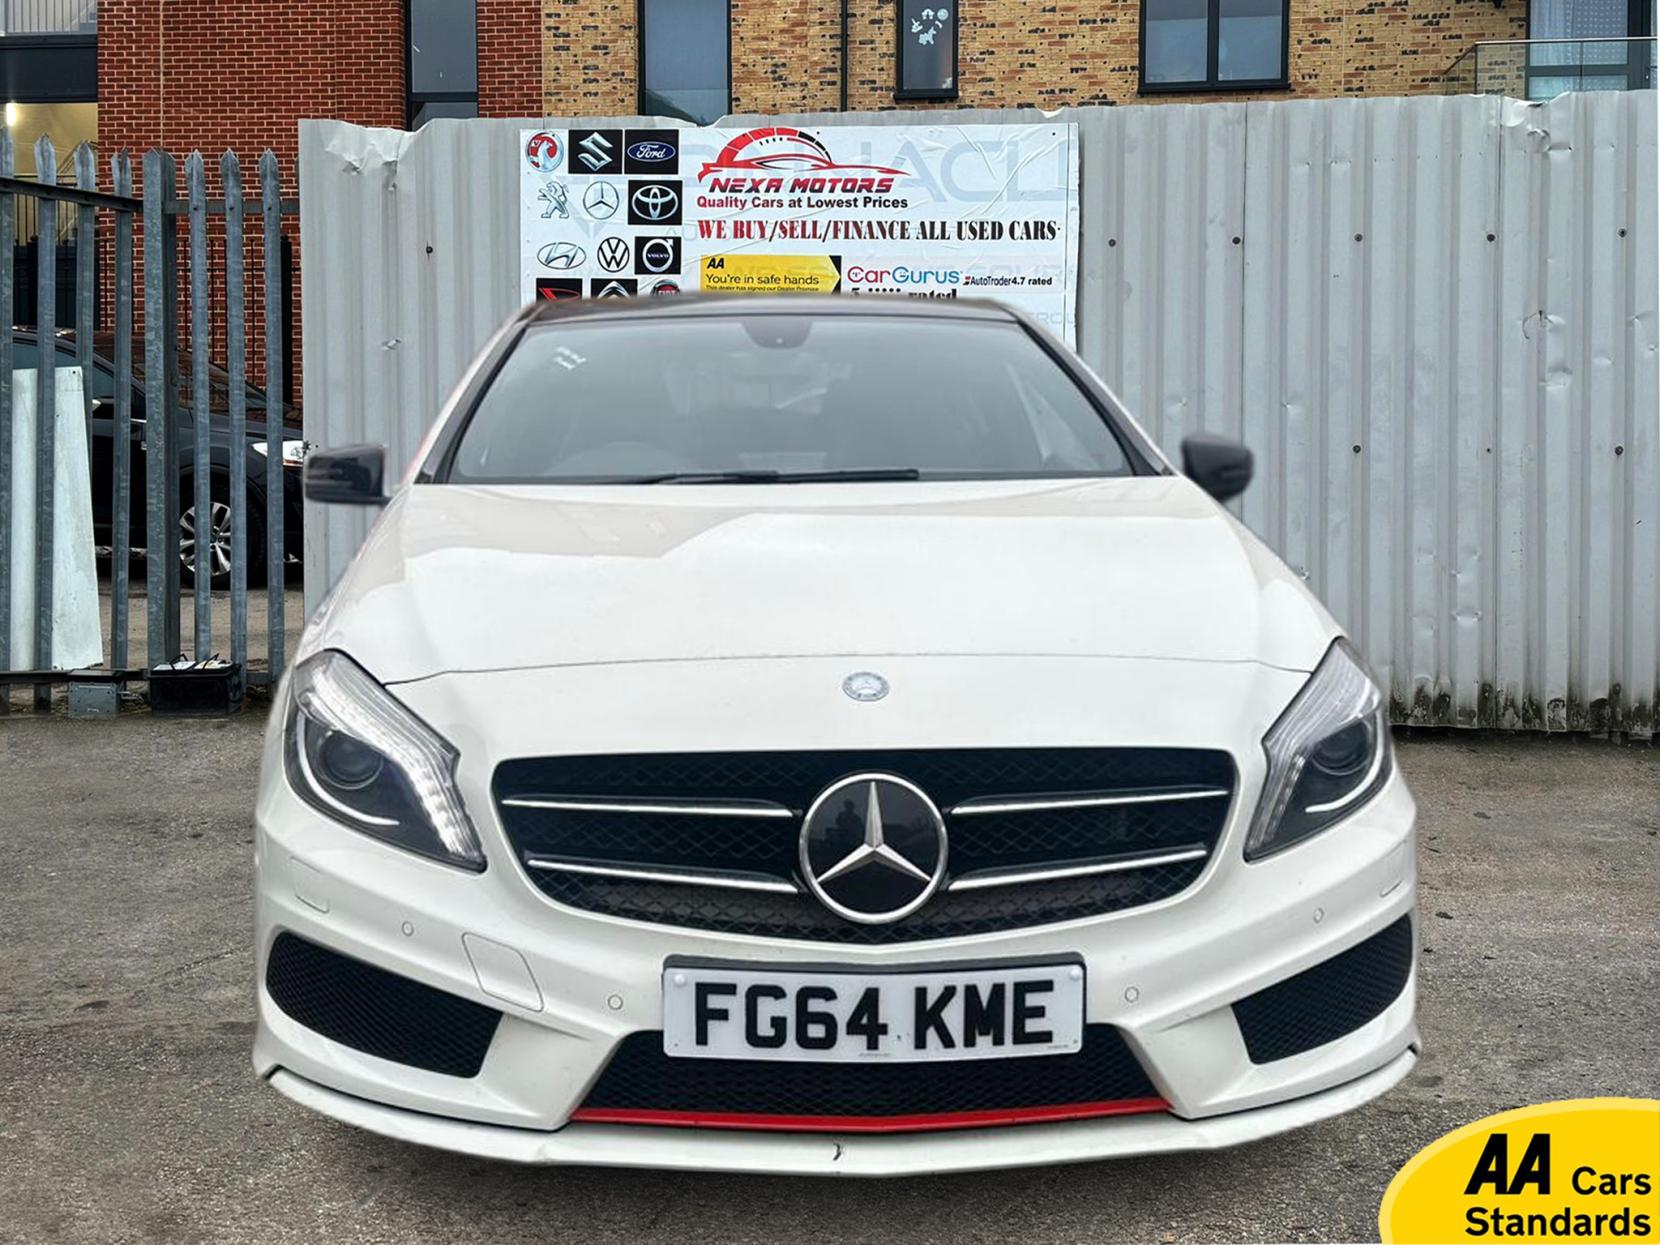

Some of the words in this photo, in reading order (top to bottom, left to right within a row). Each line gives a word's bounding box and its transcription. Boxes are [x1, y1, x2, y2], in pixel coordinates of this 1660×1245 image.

[636, 144, 666, 159] Ford
[708, 178, 783, 193] NEXA
[789, 178, 894, 193] MOTORS
[696, 196, 747, 210] Quality
[751, 196, 784, 209] Cars
[788, 197, 803, 209] at
[807, 197, 858, 209] Lowest
[863, 197, 908, 209] Prices
[698, 220, 727, 240] WE
[916, 220, 951, 240] ALL
[957, 220, 1004, 240] USED
[1009, 220, 1057, 240] CARS
[706, 258, 725, 269] AA
[706, 273, 741, 284] You're
[744, 274, 754, 284] in
[757, 274, 781, 285] safe
[784, 275, 820, 285] hands
[847, 266, 960, 284] CarGurus
[1028, 276, 1053, 286] rated
[695, 981, 889, 1050] FG64
[914, 979, 1055, 1050] KME
